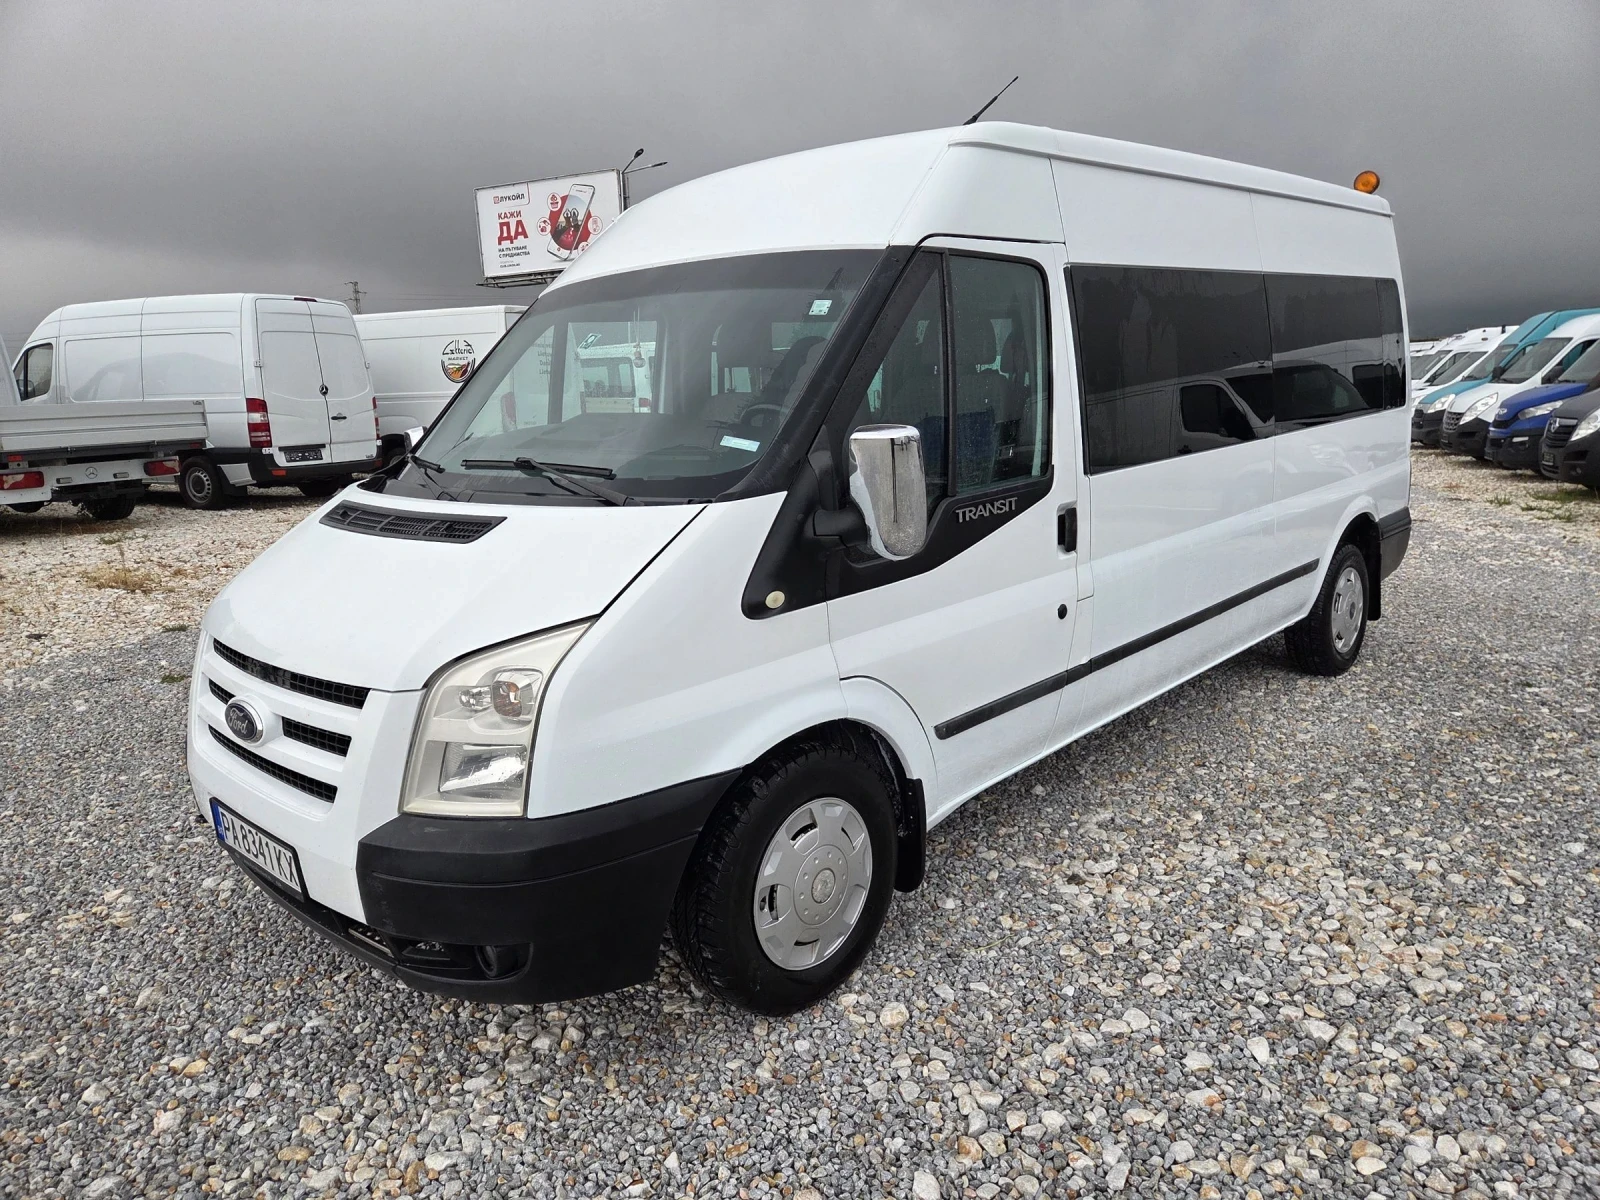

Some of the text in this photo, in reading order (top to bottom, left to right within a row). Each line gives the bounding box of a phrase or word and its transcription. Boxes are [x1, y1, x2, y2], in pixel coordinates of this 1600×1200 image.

[500, 193, 525, 203] ЛУКОЙЛ
[497, 210, 522, 220] КАЖИ
[497, 219, 529, 246] ДА
[955, 497, 1018, 523] TRANSIT
[227, 707, 249, 735] Ford
